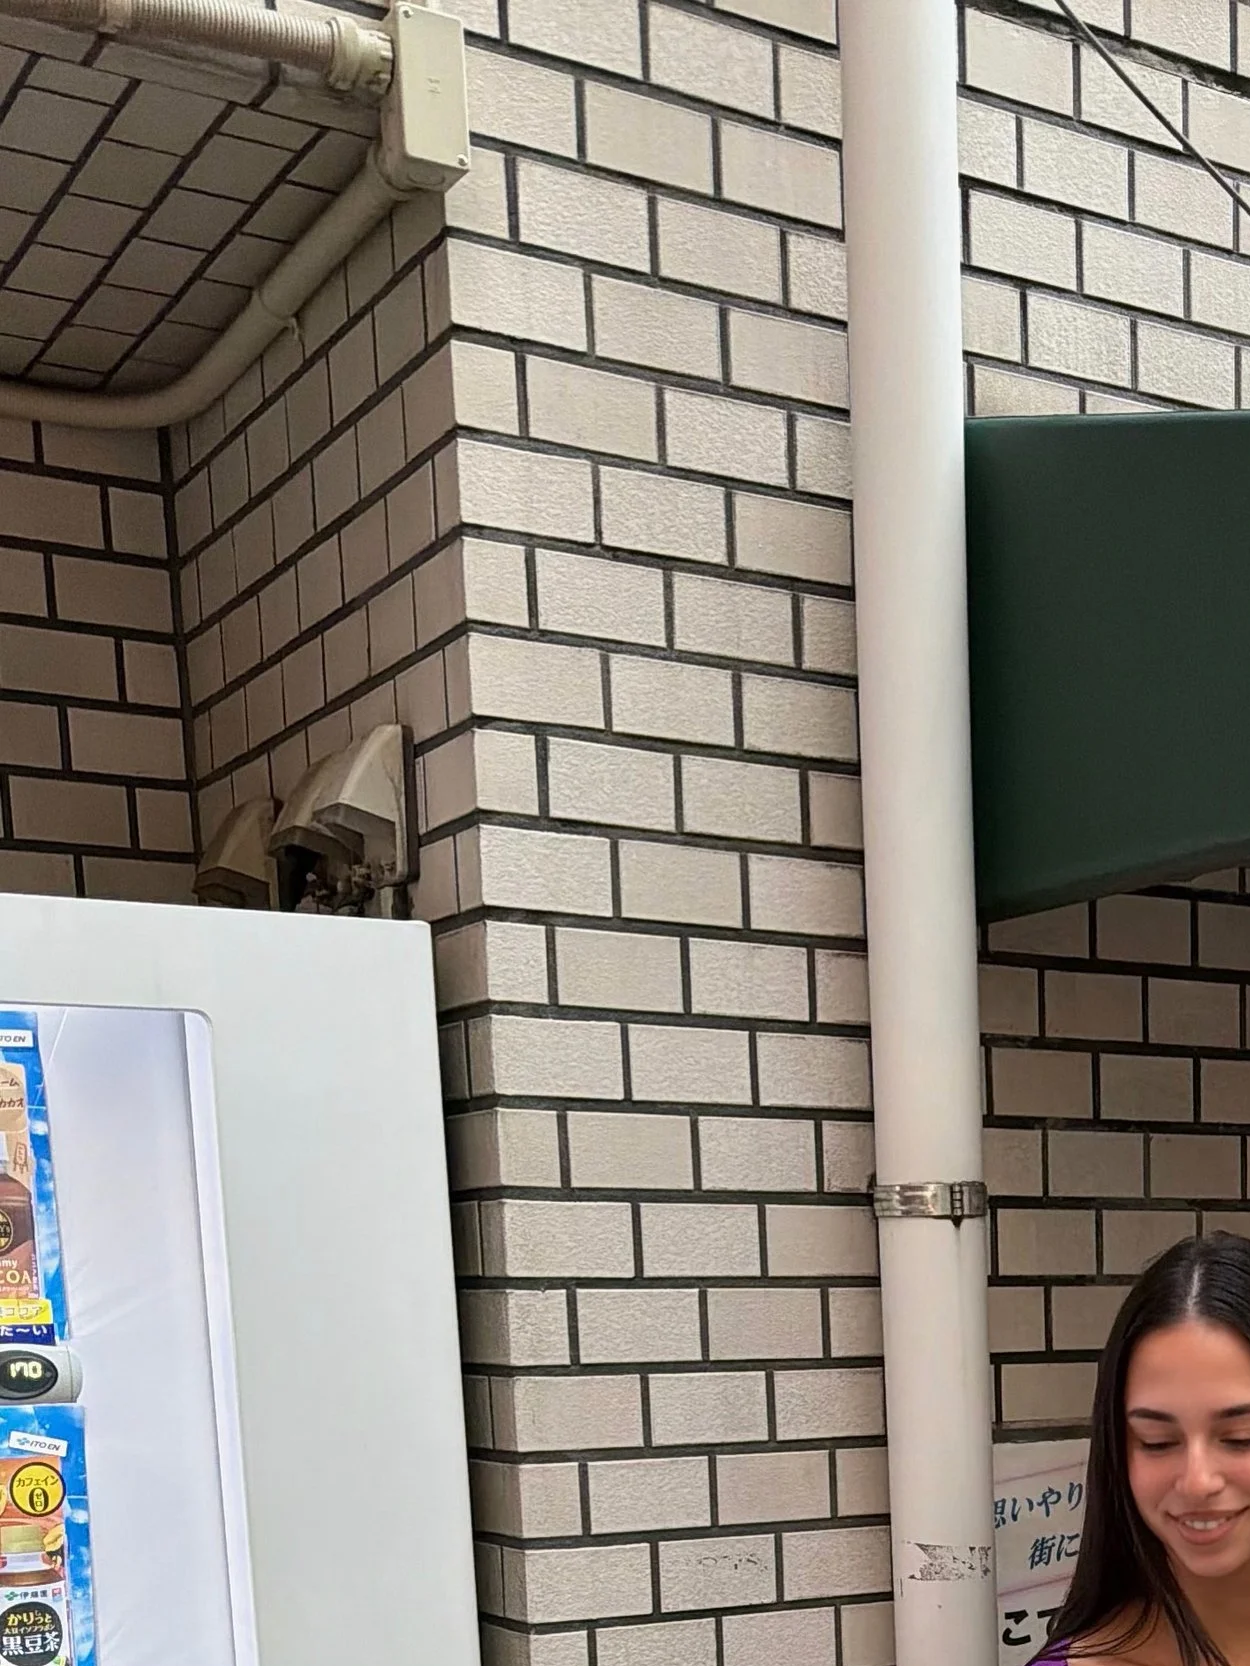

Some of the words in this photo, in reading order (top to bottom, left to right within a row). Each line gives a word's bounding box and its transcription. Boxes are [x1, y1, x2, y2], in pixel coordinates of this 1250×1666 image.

[16, 1474, 59, 1488] カフェイン
[1028, 1532, 1081, 1571] 街に
[2, 1631, 60, 1656] 黒豆茶
